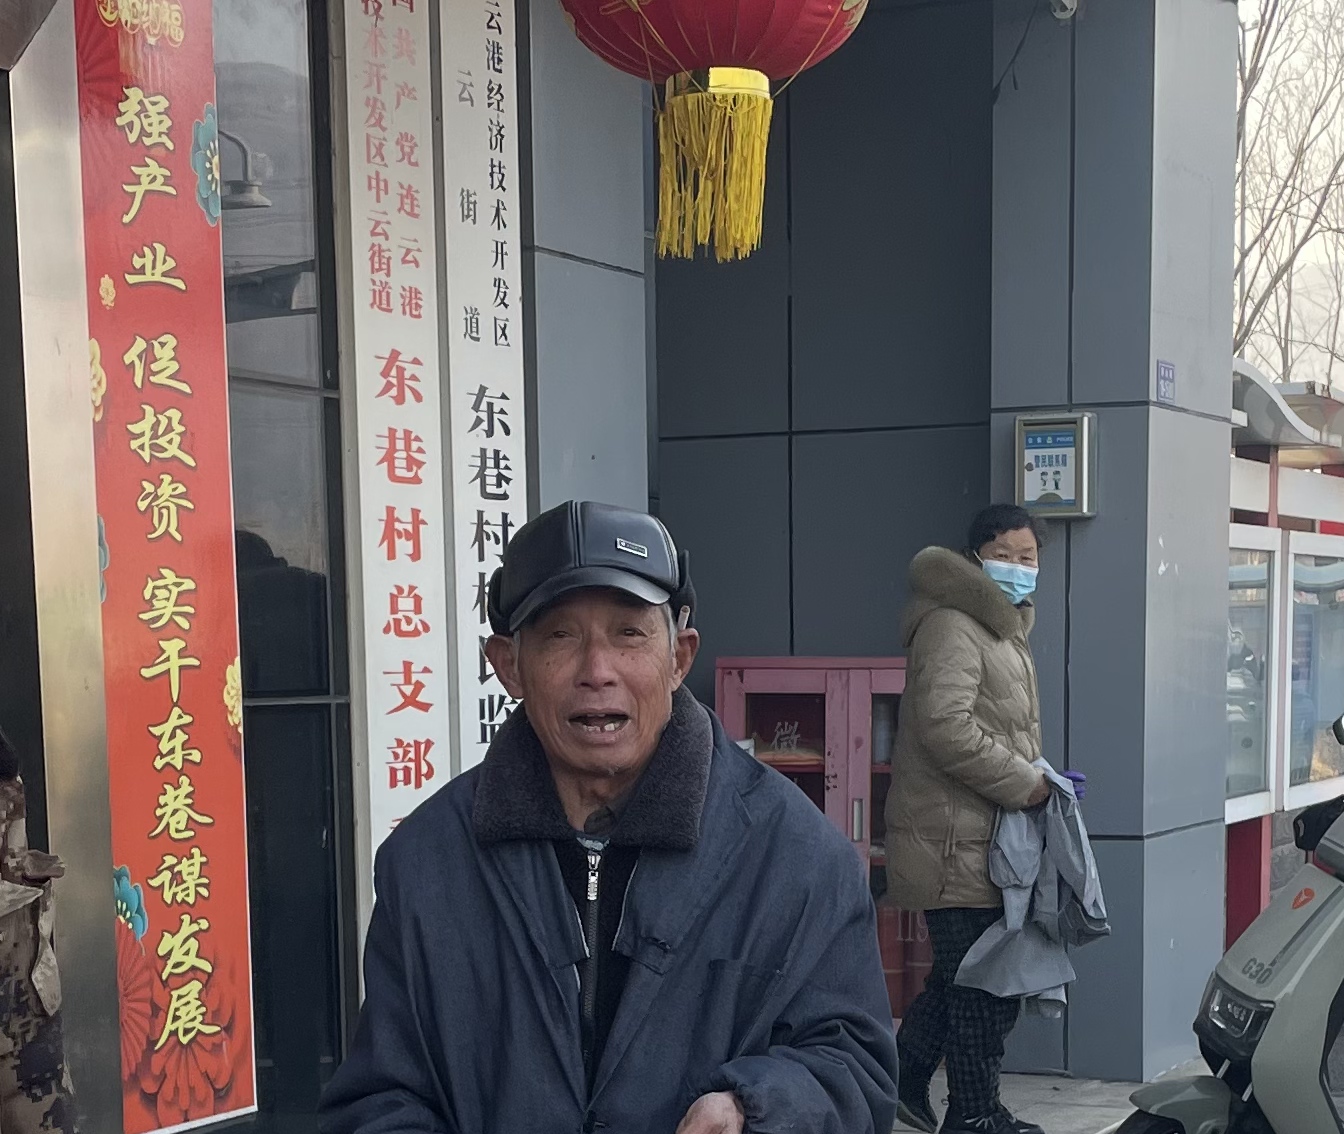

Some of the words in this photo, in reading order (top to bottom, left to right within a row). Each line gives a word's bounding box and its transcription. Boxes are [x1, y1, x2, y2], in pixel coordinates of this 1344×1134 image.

[374, 349, 436, 830] 东巷村总支部
